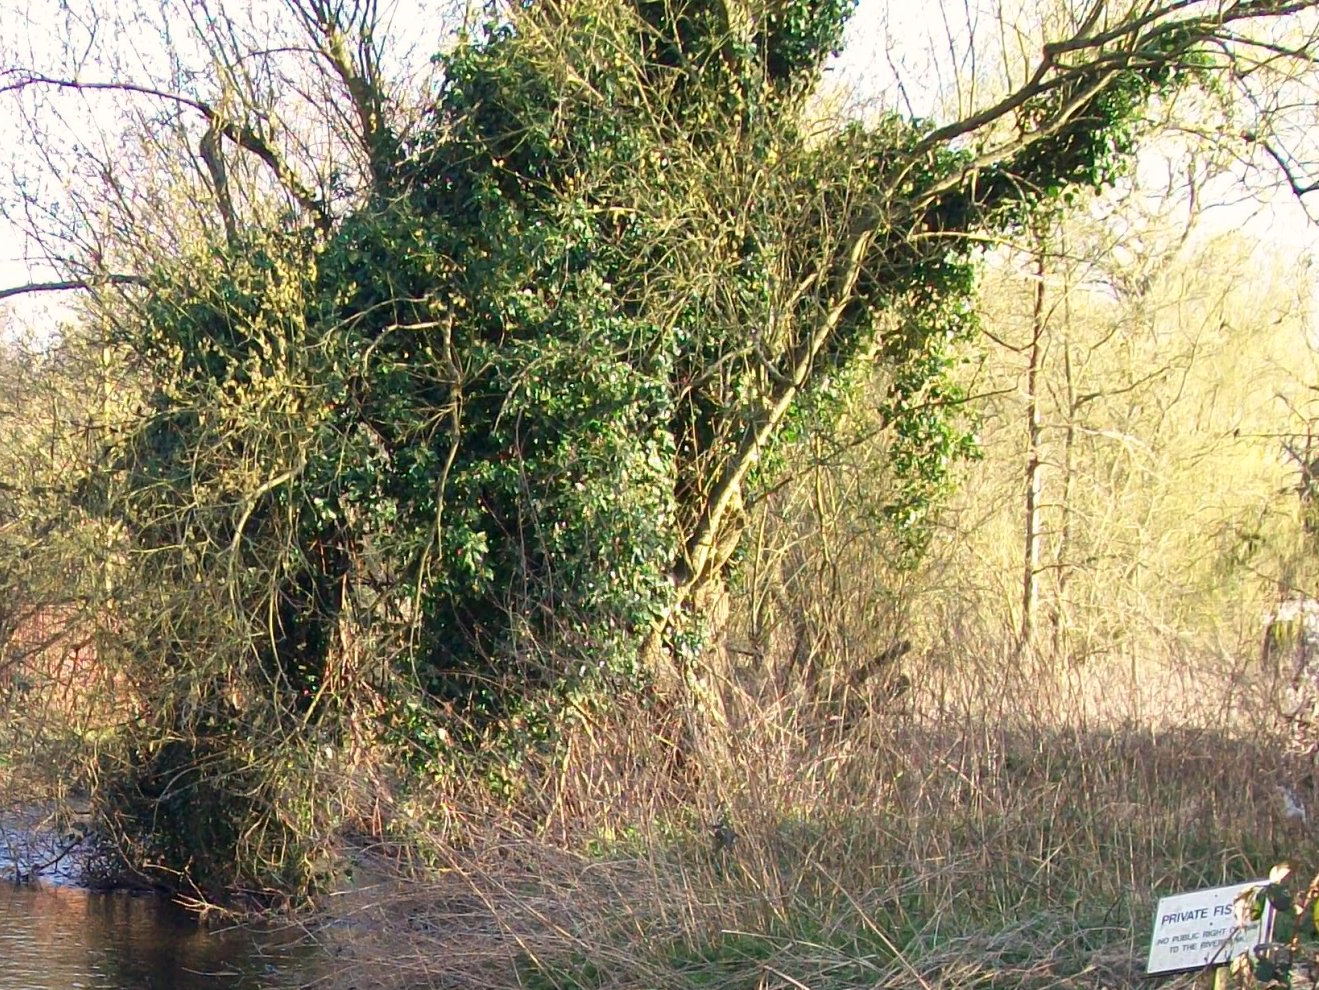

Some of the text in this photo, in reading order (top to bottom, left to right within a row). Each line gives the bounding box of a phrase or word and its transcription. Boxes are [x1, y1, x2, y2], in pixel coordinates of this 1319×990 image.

[1161, 903, 1233, 925] PRIVATE FIS
[1157, 937, 1169, 945] NO
[1172, 932, 1199, 942] PUBLIC
[1202, 928, 1226, 938] RIGHT
[1182, 943, 1197, 951] THE
